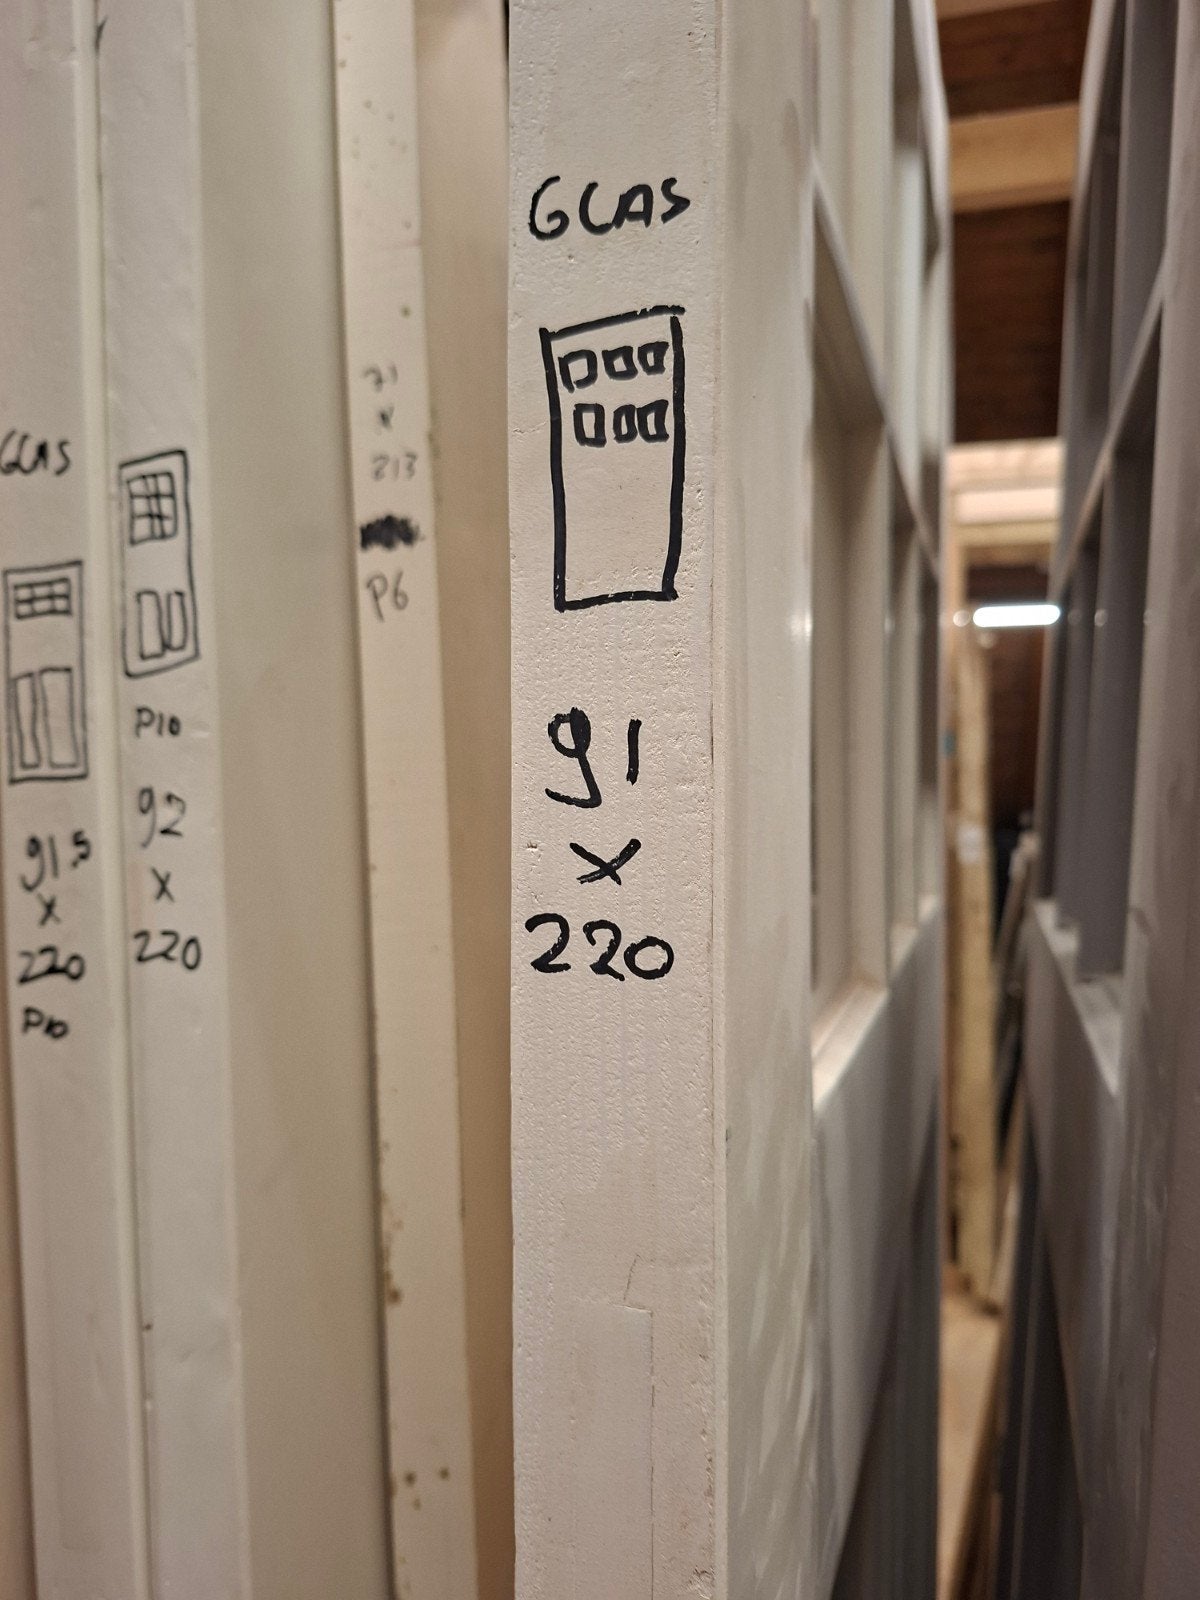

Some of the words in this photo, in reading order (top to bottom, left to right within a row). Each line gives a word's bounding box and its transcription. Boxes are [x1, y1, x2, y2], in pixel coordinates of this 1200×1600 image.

[545, 706, 642, 809] 91
[138, 786, 187, 849] 92
[18, 946, 86, 986] 220
[133, 930, 202, 971] 220
[524, 912, 675, 981] 220
